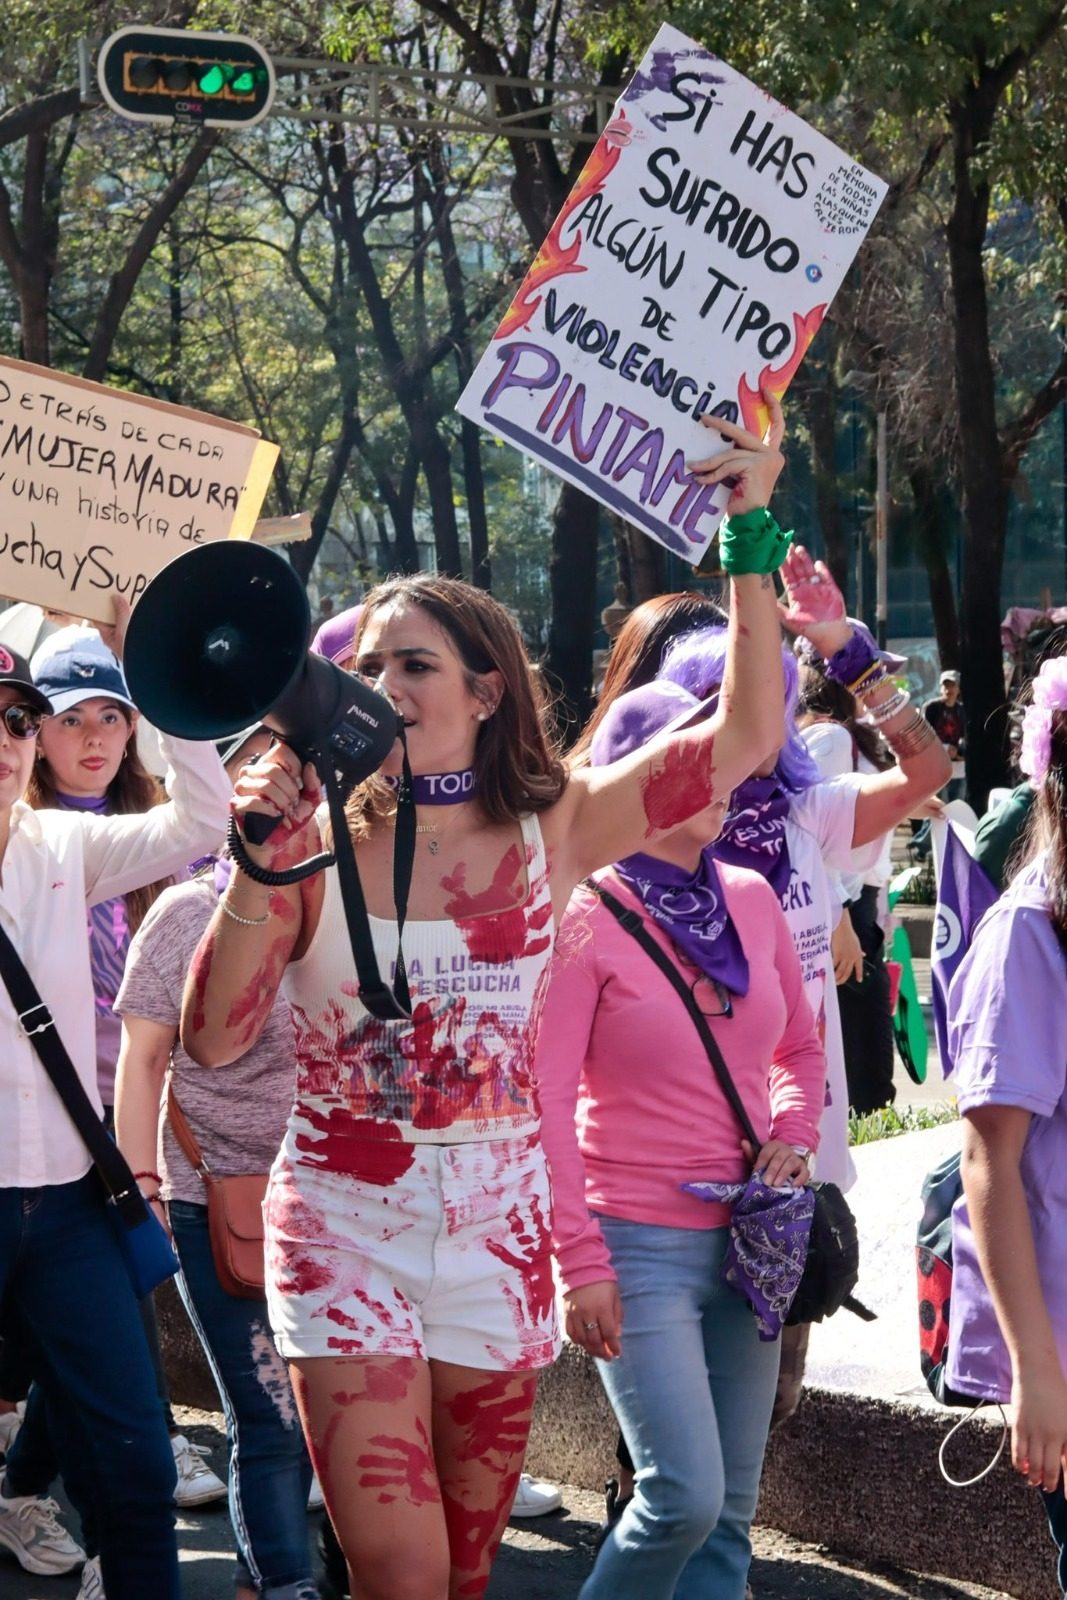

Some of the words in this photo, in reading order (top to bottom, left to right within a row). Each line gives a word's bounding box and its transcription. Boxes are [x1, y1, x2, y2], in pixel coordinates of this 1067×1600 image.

[730, 110, 815, 199] HAS
[851, 165, 863, 177] EN
[821, 182, 837, 197] LAS
[828, 172, 840, 184] DE
[842, 183, 873, 207] TODAS
[838, 166, 877, 199] MEMORIA
[639, 147, 800, 273] SUFRIDO
[828, 210, 843, 225] LES
[568, 193, 685, 290] ALGÚN
[640, 297, 676, 341] DE
[121, 421, 148, 442] DE
[158, 433, 224, 461] CADA
[481, 341, 738, 543] PINTAME
[12, 478, 58, 506] UNA
[88, 545, 151, 605] Sup
[735, 826, 759, 841] ES
